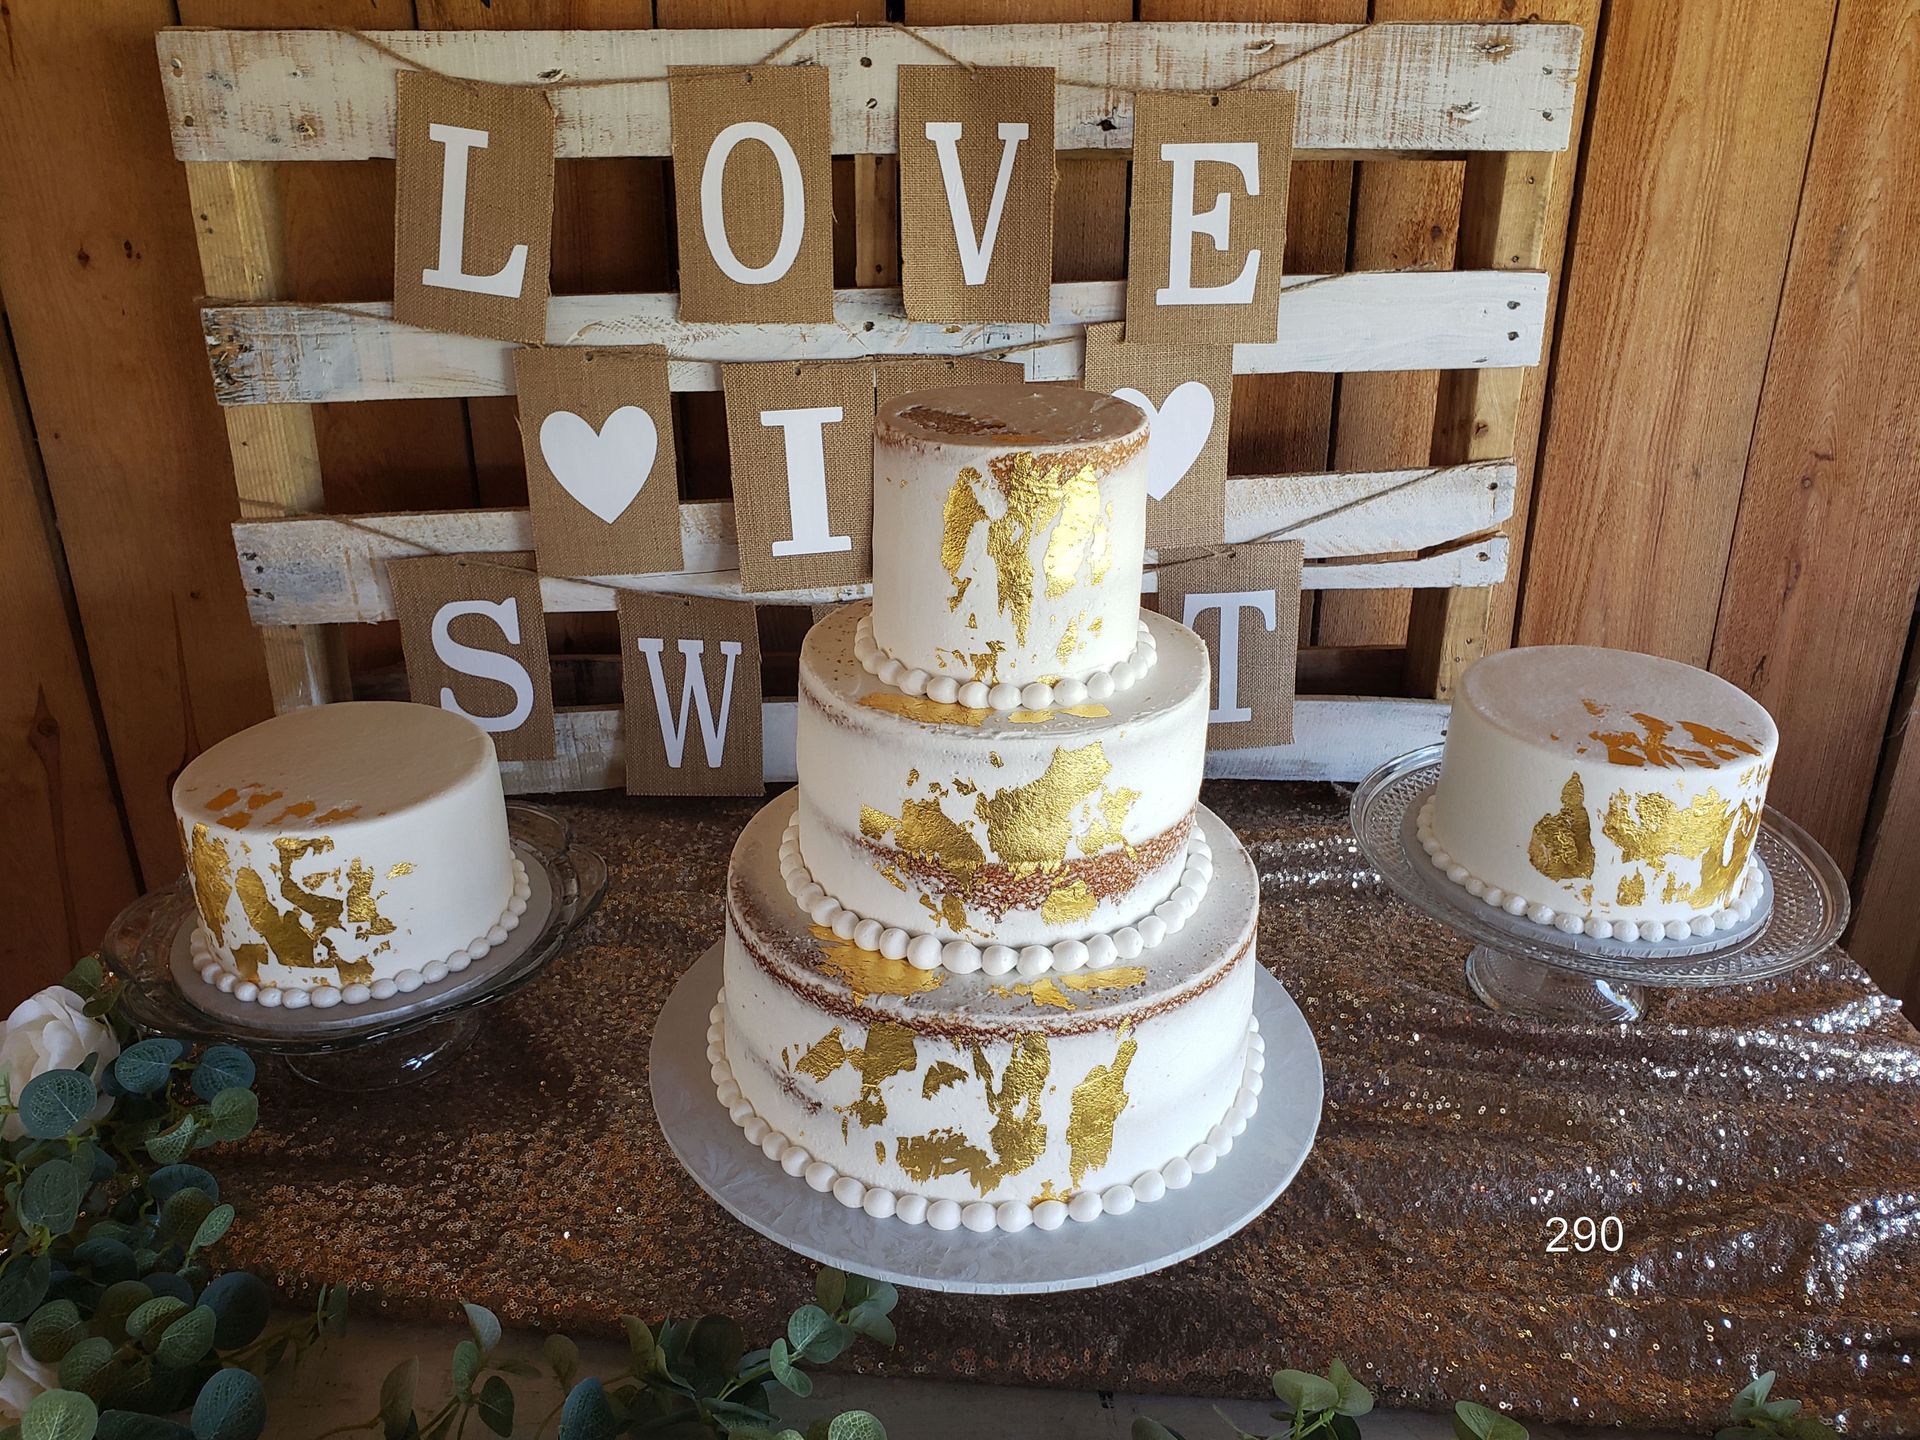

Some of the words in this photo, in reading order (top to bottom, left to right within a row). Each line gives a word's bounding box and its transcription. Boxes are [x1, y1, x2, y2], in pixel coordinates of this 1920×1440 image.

[422, 121, 1260, 305] LOVE
[760, 406, 852, 557] I
[431, 590, 1277, 768] SWT
